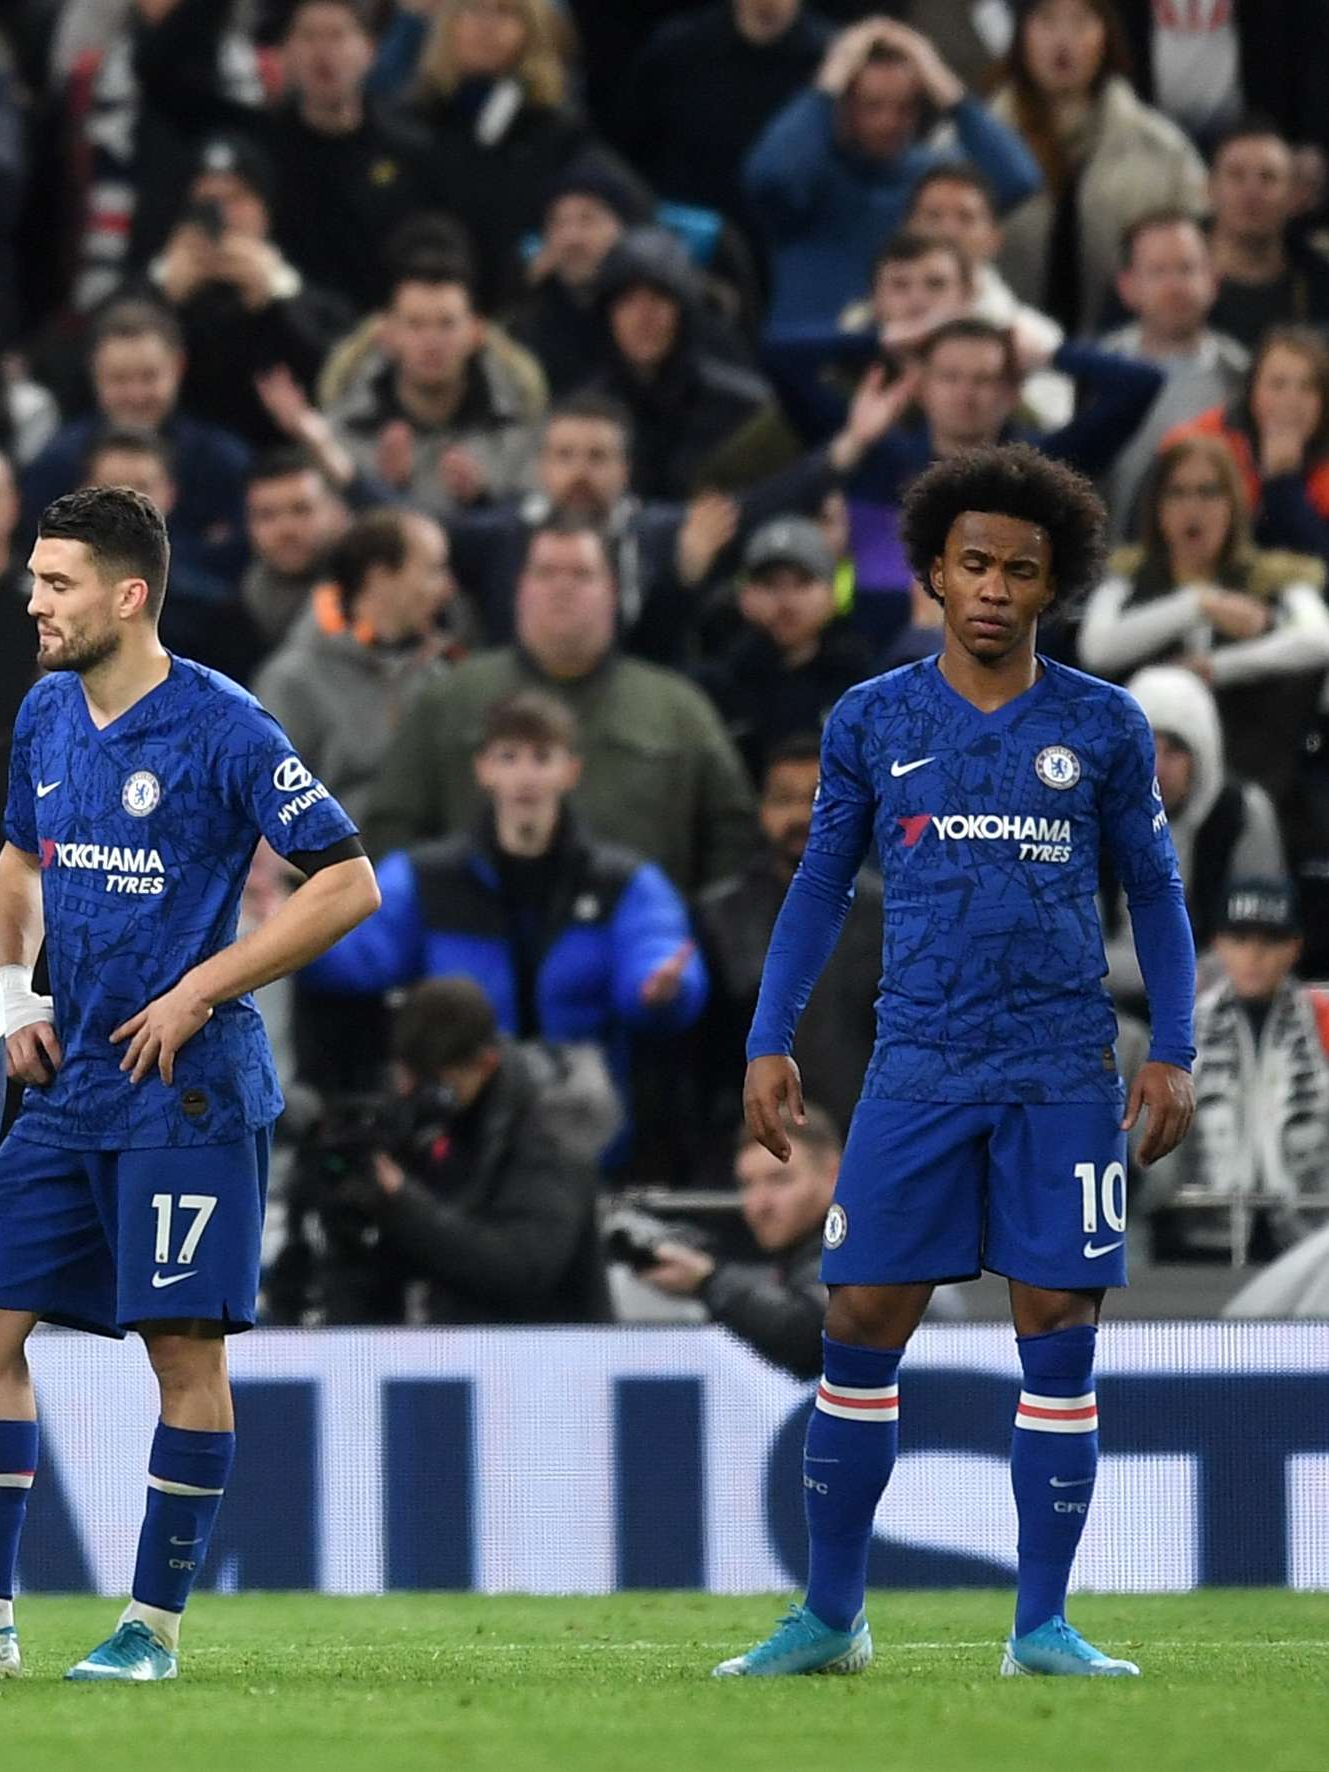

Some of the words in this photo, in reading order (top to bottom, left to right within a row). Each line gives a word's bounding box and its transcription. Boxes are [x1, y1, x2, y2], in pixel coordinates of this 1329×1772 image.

[932, 815, 1070, 843] YOKOHAMA
[54, 842, 165, 874] YOKOHAMA
[1018, 843, 1072, 863] TYRES
[105, 875, 165, 895] TYRES
[1074, 1161, 1127, 1233] 10
[151, 1193, 219, 1265] 17
[1053, 1501, 1088, 1514] CFC
[169, 1558, 196, 1571] CFC
